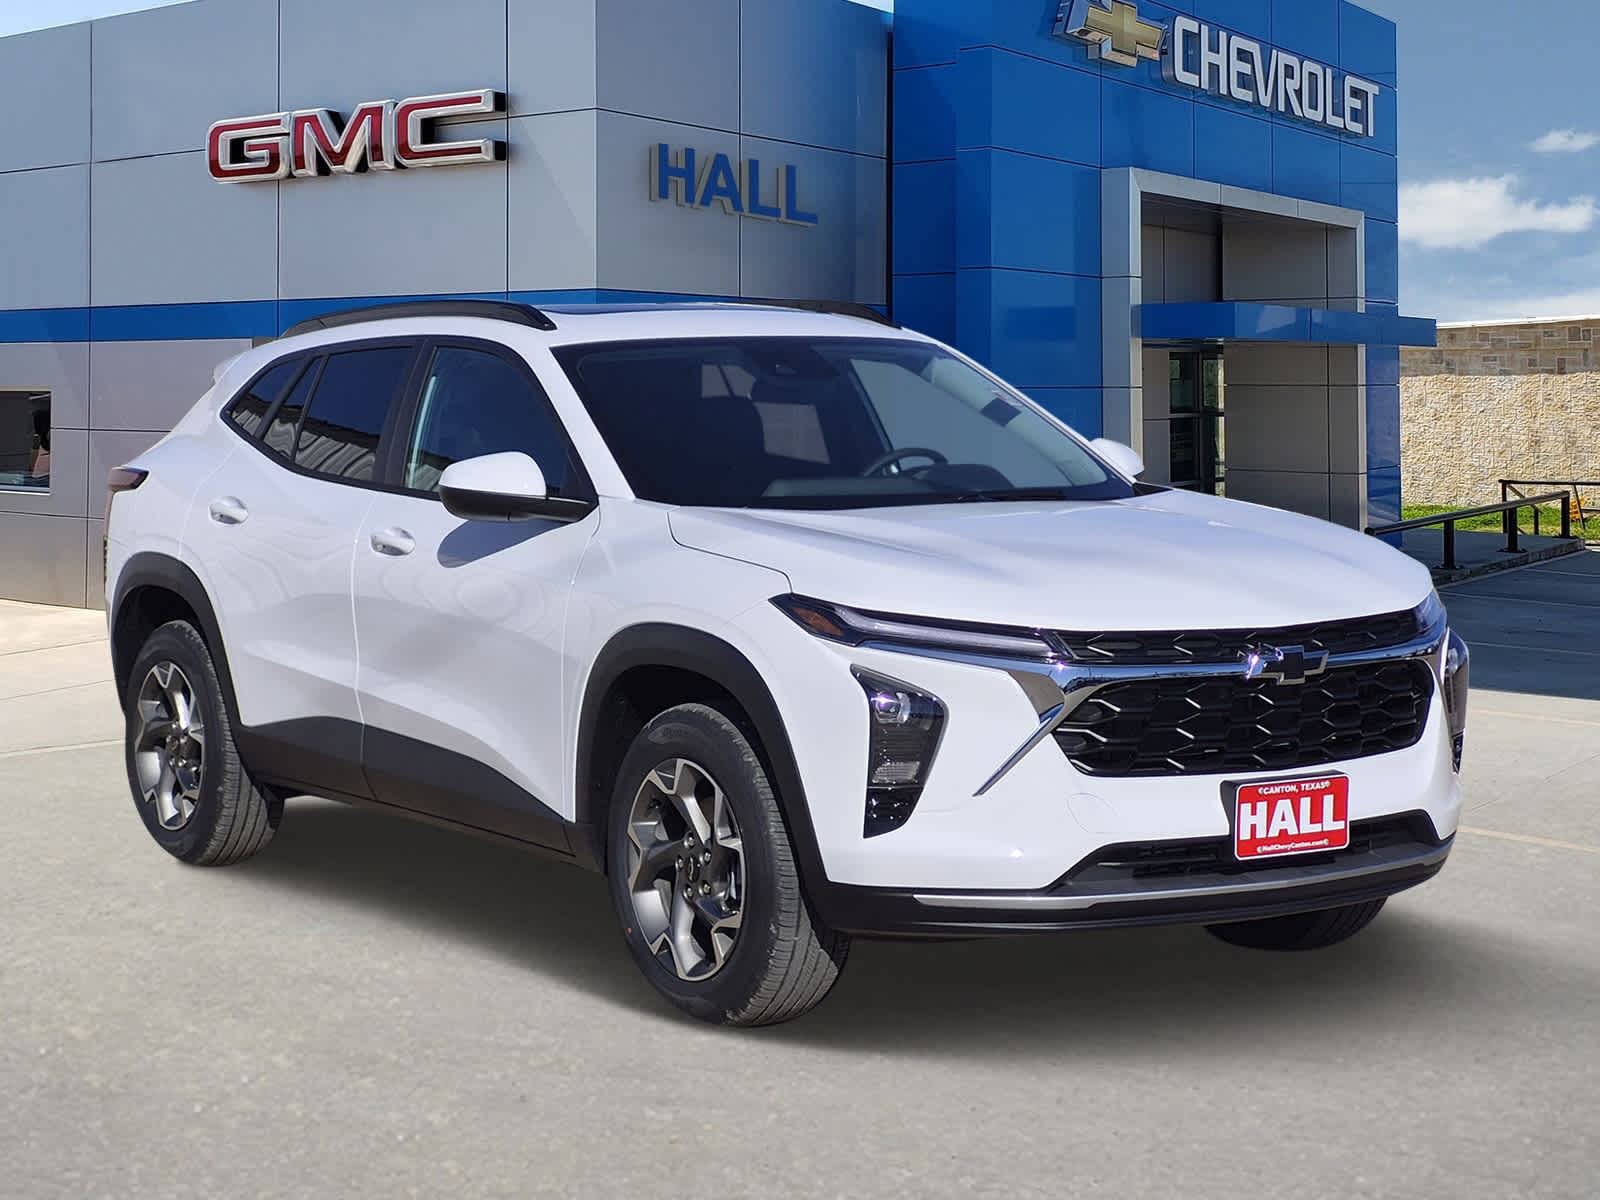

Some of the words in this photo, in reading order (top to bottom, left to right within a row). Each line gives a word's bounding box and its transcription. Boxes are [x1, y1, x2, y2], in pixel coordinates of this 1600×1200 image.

[1174, 15, 1380, 137] CHEVROLET
[206, 88, 506, 184] GMC
[651, 143, 818, 227] HALL
[1239, 794, 1345, 841] HALL
[1263, 784, 1299, 795] CANTON,
[1300, 781, 1326, 792] TEXAS
